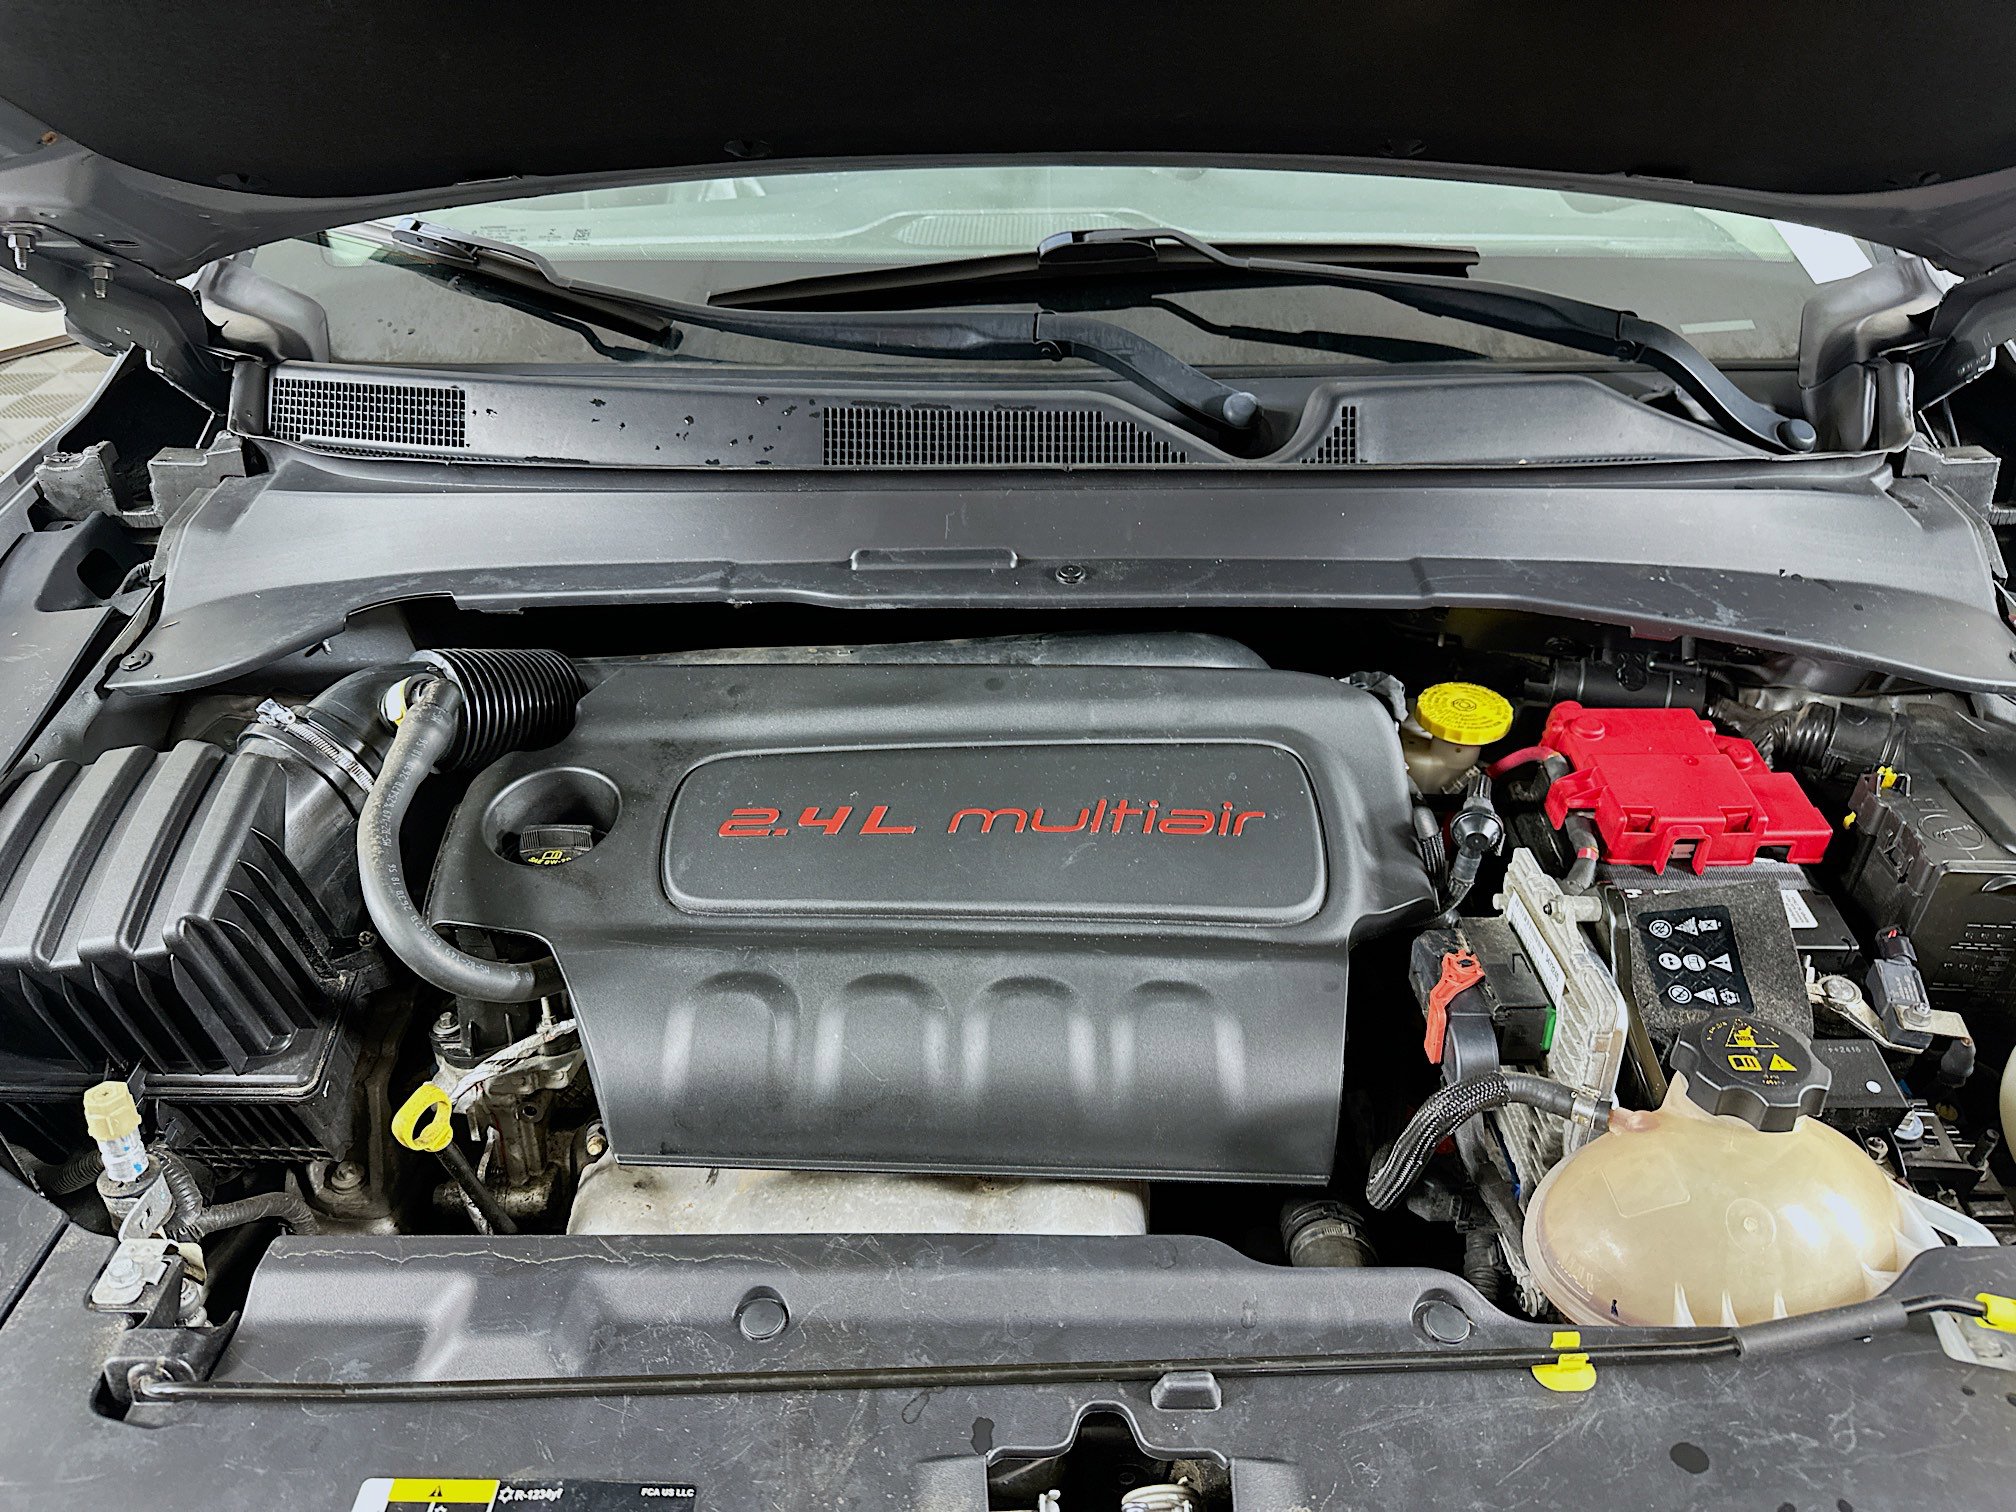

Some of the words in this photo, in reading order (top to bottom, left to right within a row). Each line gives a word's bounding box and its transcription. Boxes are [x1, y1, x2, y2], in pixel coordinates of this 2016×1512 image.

[947, 798, 1267, 837] multiair
[528, 857, 544, 865] SAE
[640, 1487, 661, 1497] FCA
[661, 1487, 675, 1497] US
[676, 1488, 695, 1498] LLC
